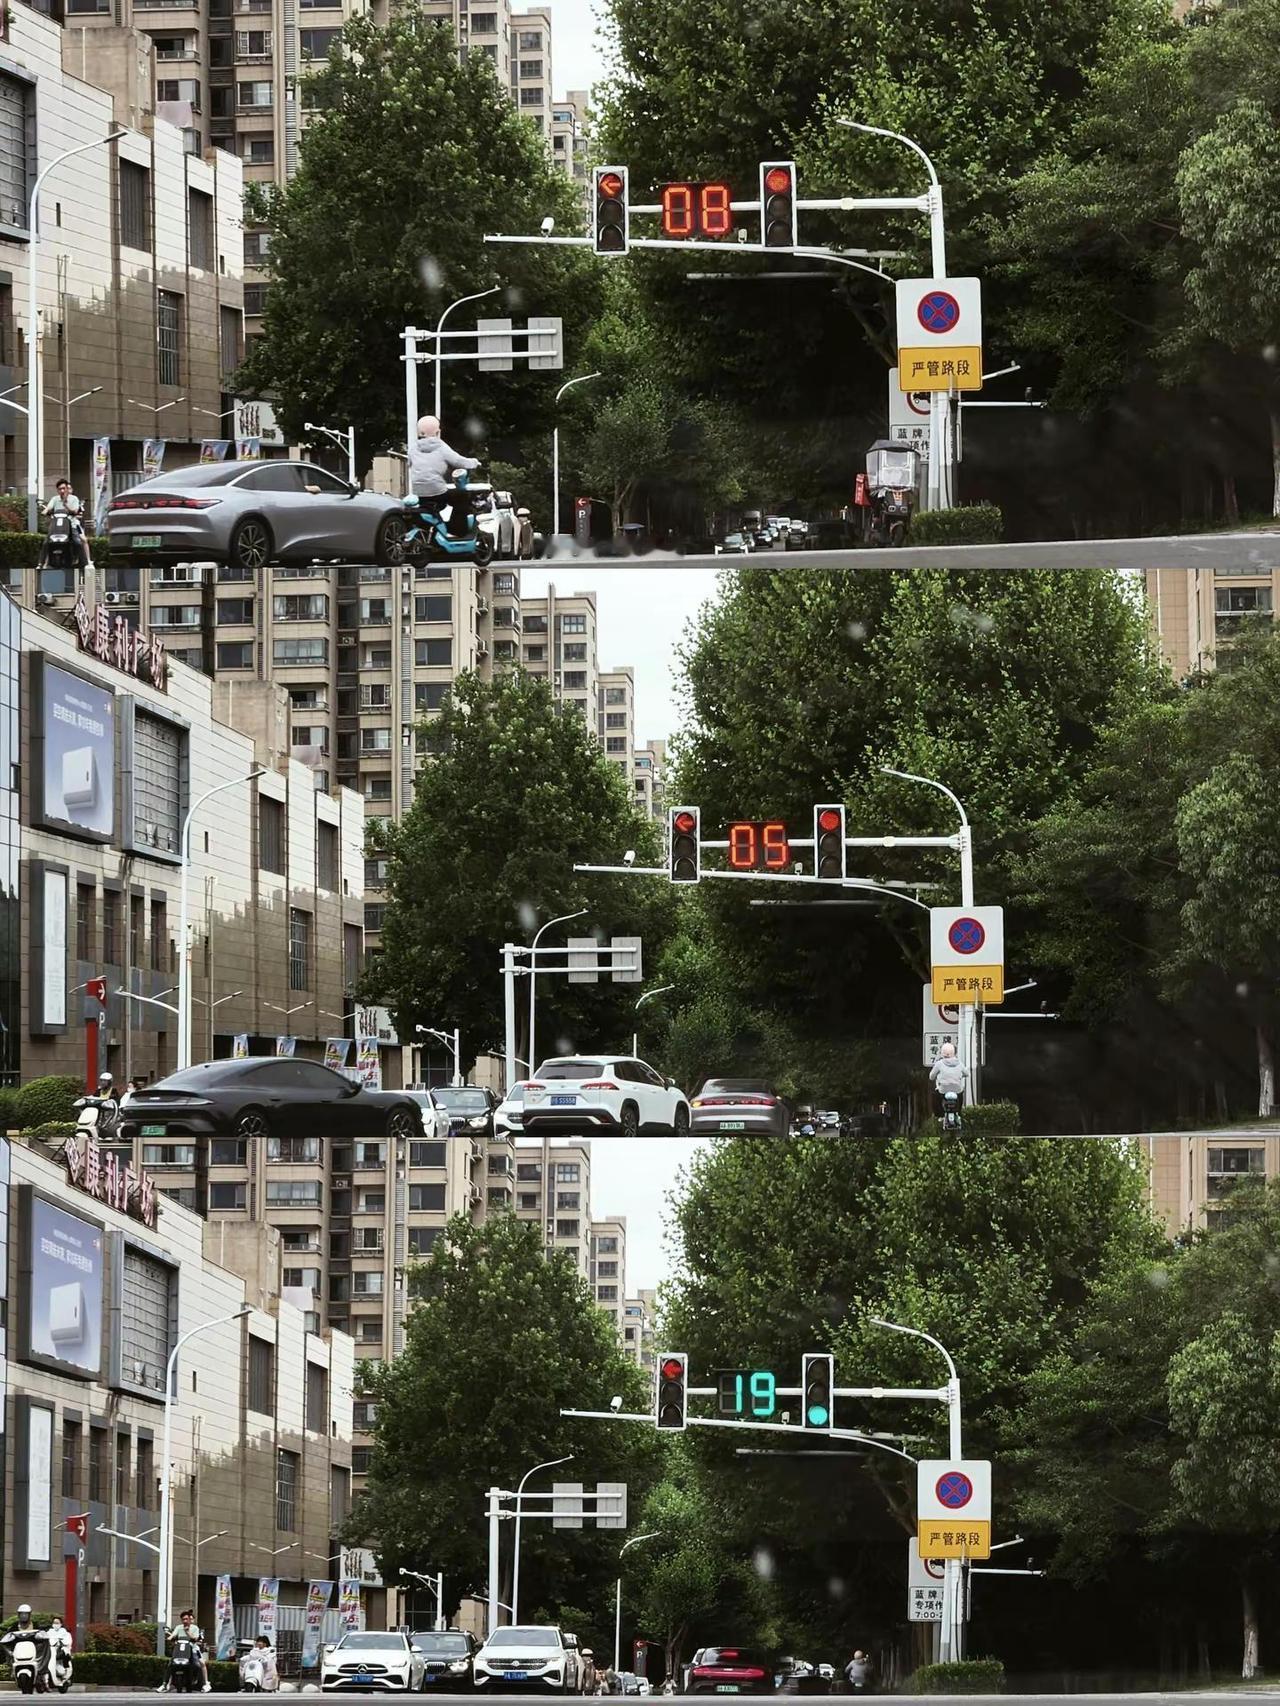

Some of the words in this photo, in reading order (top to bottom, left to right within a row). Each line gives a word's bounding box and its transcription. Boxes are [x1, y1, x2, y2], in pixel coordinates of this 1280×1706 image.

[664, 186, 728, 233] 08
[912, 360, 970, 377] 严管路段
[731, 824, 786, 866] 05
[943, 977, 993, 991] 严管路段
[735, 1372, 775, 1415] 19
[929, 1532, 980, 1546] 严管路段
